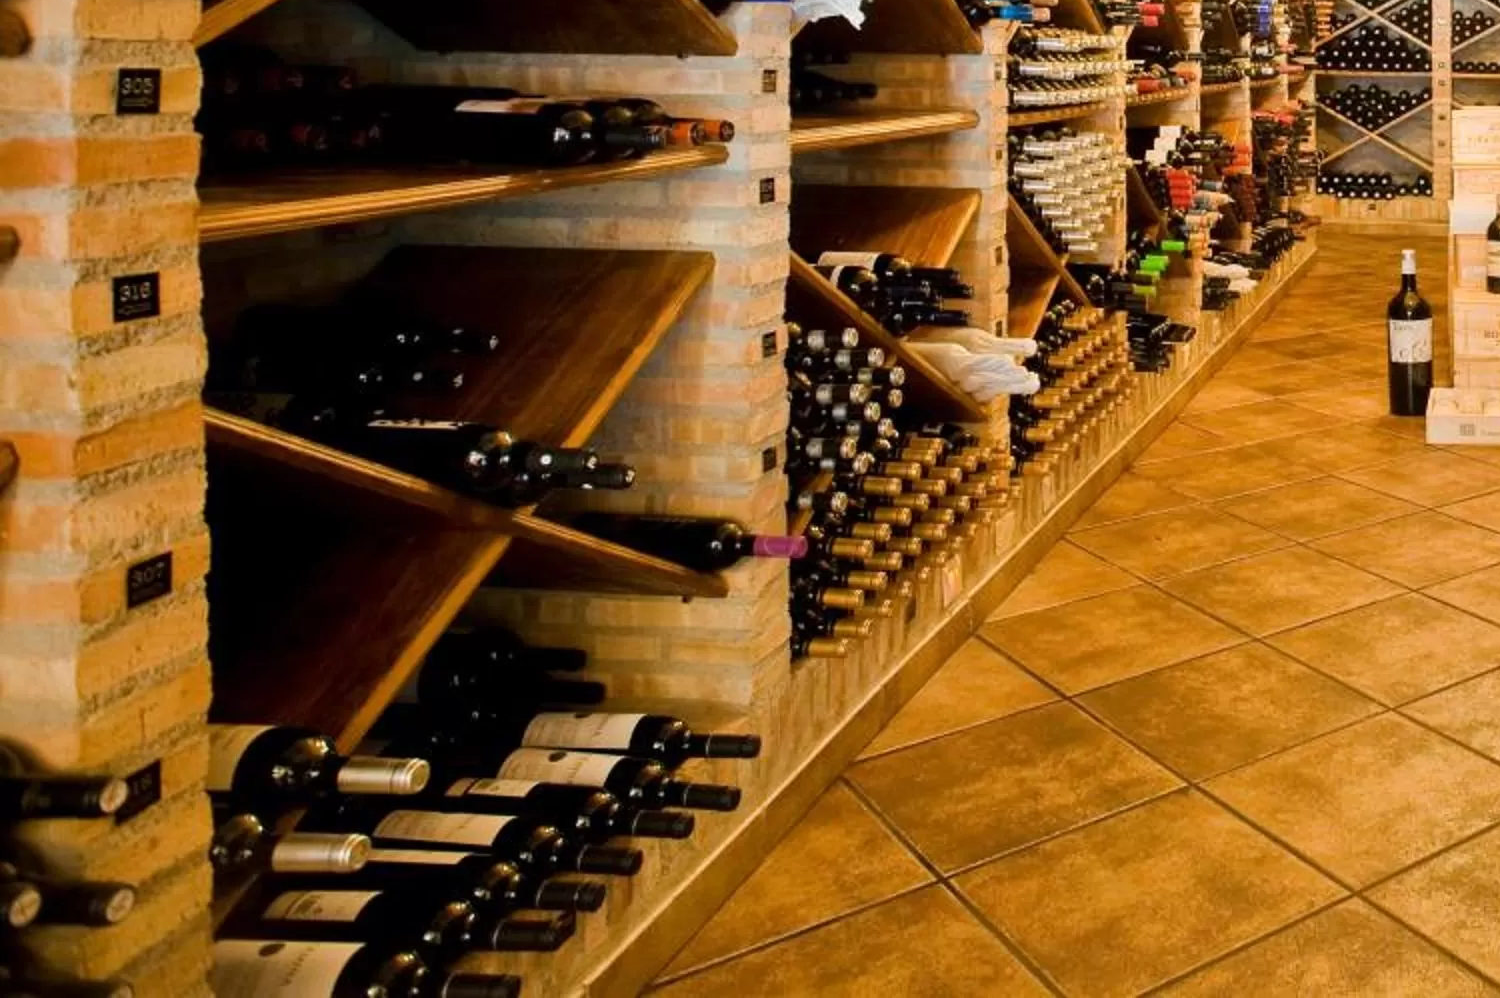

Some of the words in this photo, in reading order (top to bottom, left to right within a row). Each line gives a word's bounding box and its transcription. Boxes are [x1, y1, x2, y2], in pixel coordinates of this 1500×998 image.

[120, 77, 154, 94] 305
[119, 281, 152, 302] 316
[131, 562, 165, 588] 307
